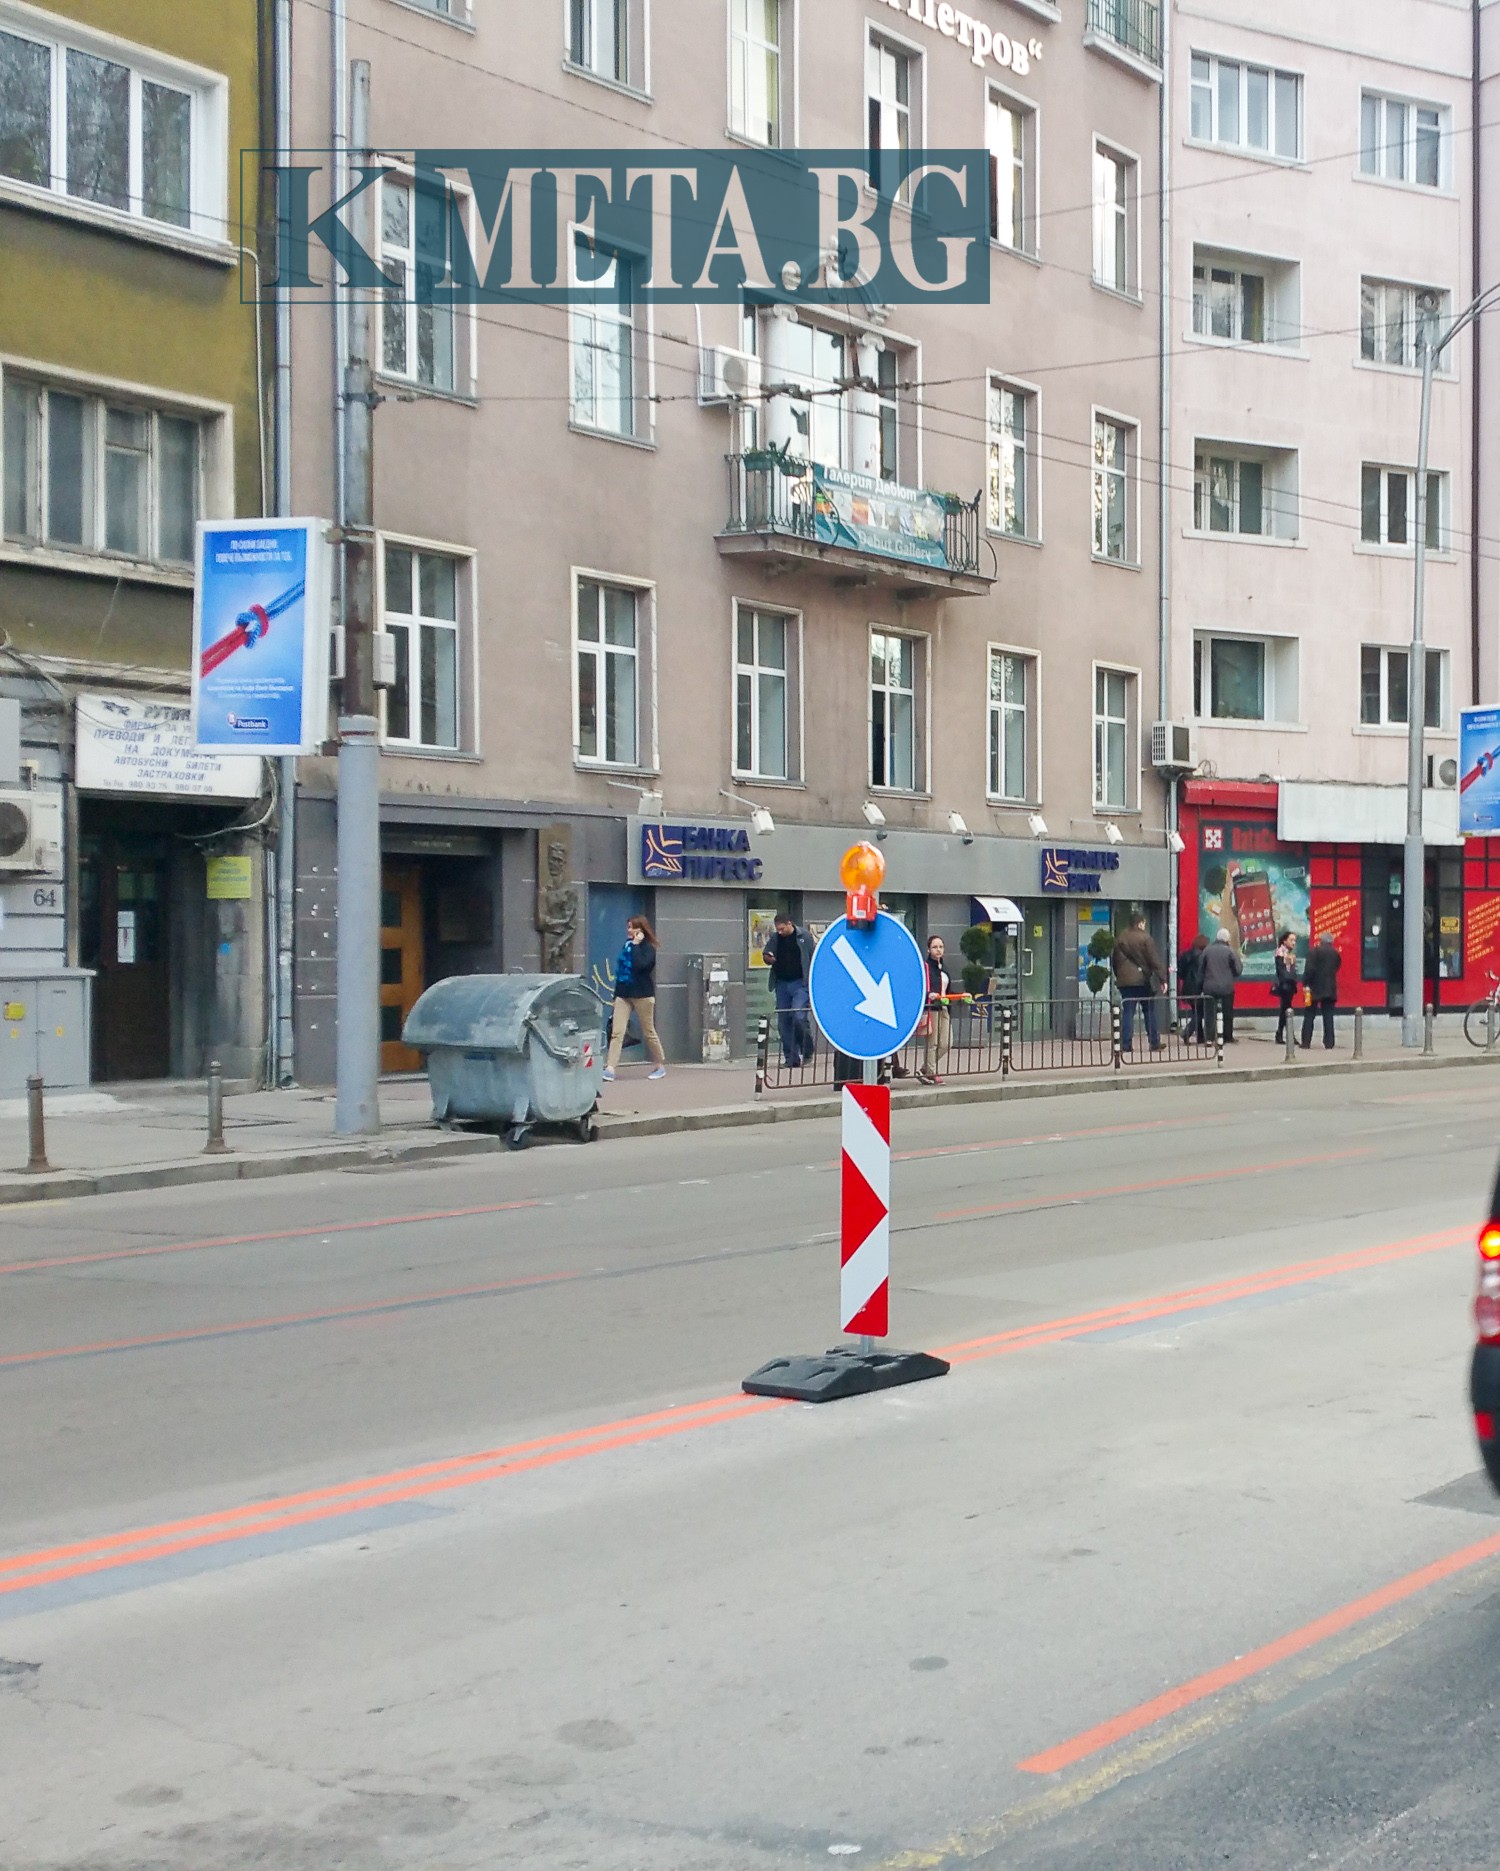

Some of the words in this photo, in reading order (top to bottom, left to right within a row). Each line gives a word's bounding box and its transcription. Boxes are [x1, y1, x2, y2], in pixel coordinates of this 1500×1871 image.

[823, 465, 873, 489] Галерия
[237, 719, 267, 729] Postbank
[94, 729, 145, 742] ПРЕВОДИ
[153, 733, 161, 743] И
[125, 744, 139, 754] НА
[113, 756, 169, 768] АВТОБУСНИ
[185, 761, 222, 772] БИЛЕТИ
[136, 769, 205, 781] ЗАСТРАХОВКИ
[684, 826, 751, 852] БАНКА
[684, 856, 764, 881] ПИРЕОС
[33, 888, 57, 908] 64
